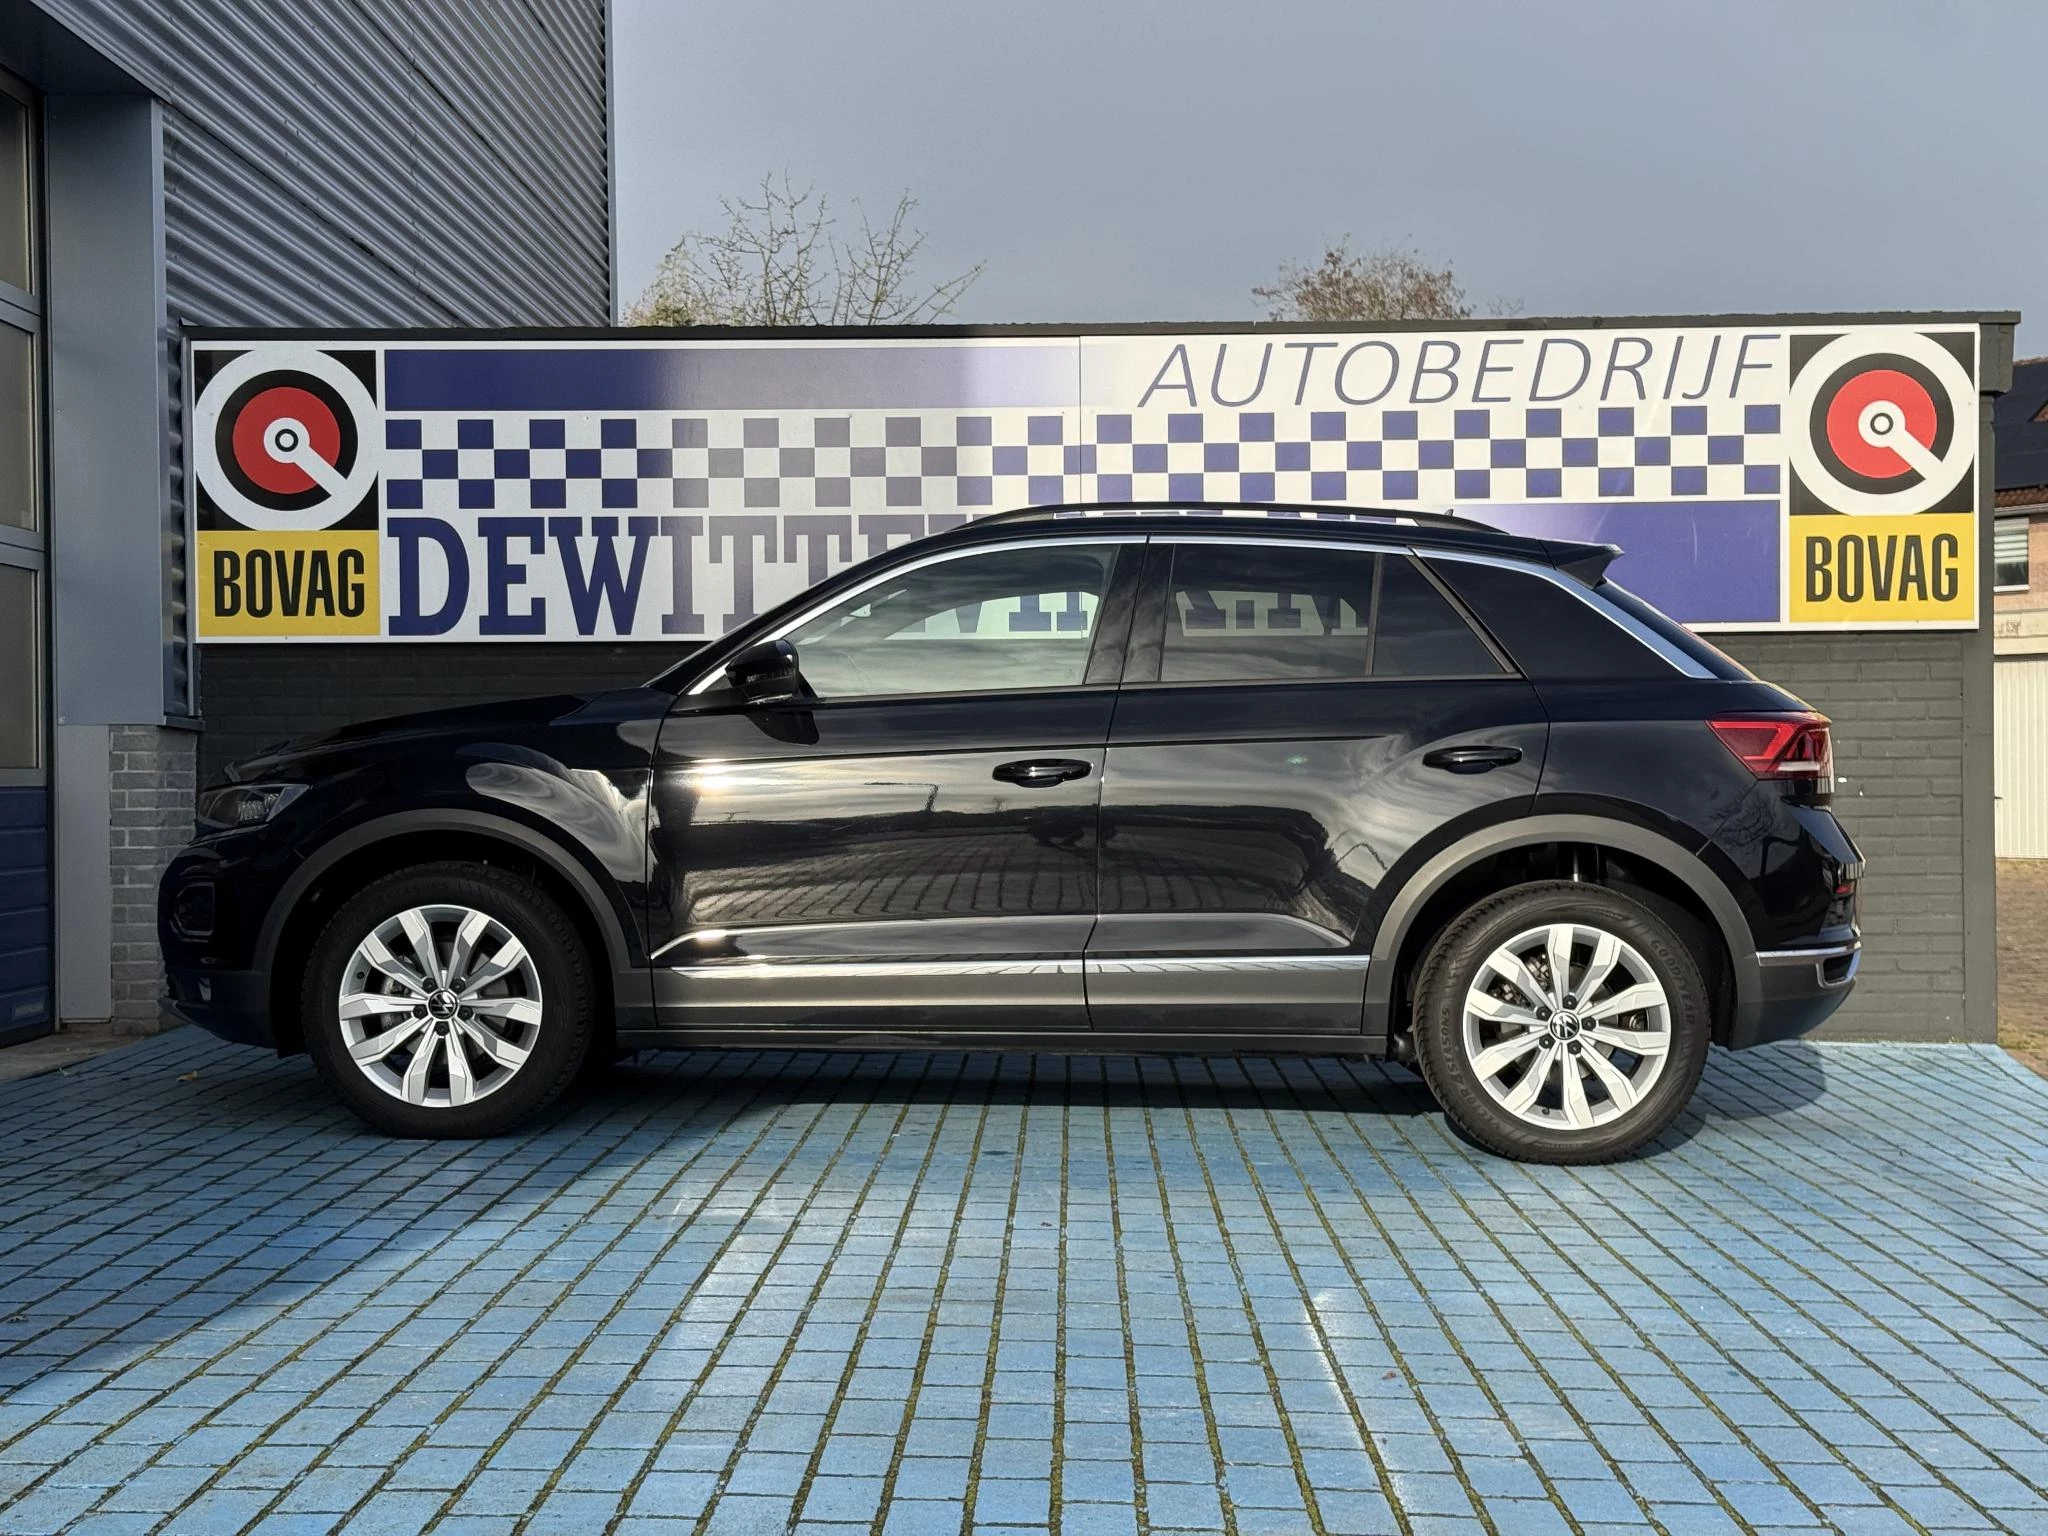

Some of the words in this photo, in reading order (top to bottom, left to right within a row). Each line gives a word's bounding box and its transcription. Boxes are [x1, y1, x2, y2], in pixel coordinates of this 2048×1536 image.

[1137, 333, 1782, 408] AUTOBEDRIJF
[213, 548, 366, 618] BOVAG
[1805, 533, 1959, 603] BOVAG
